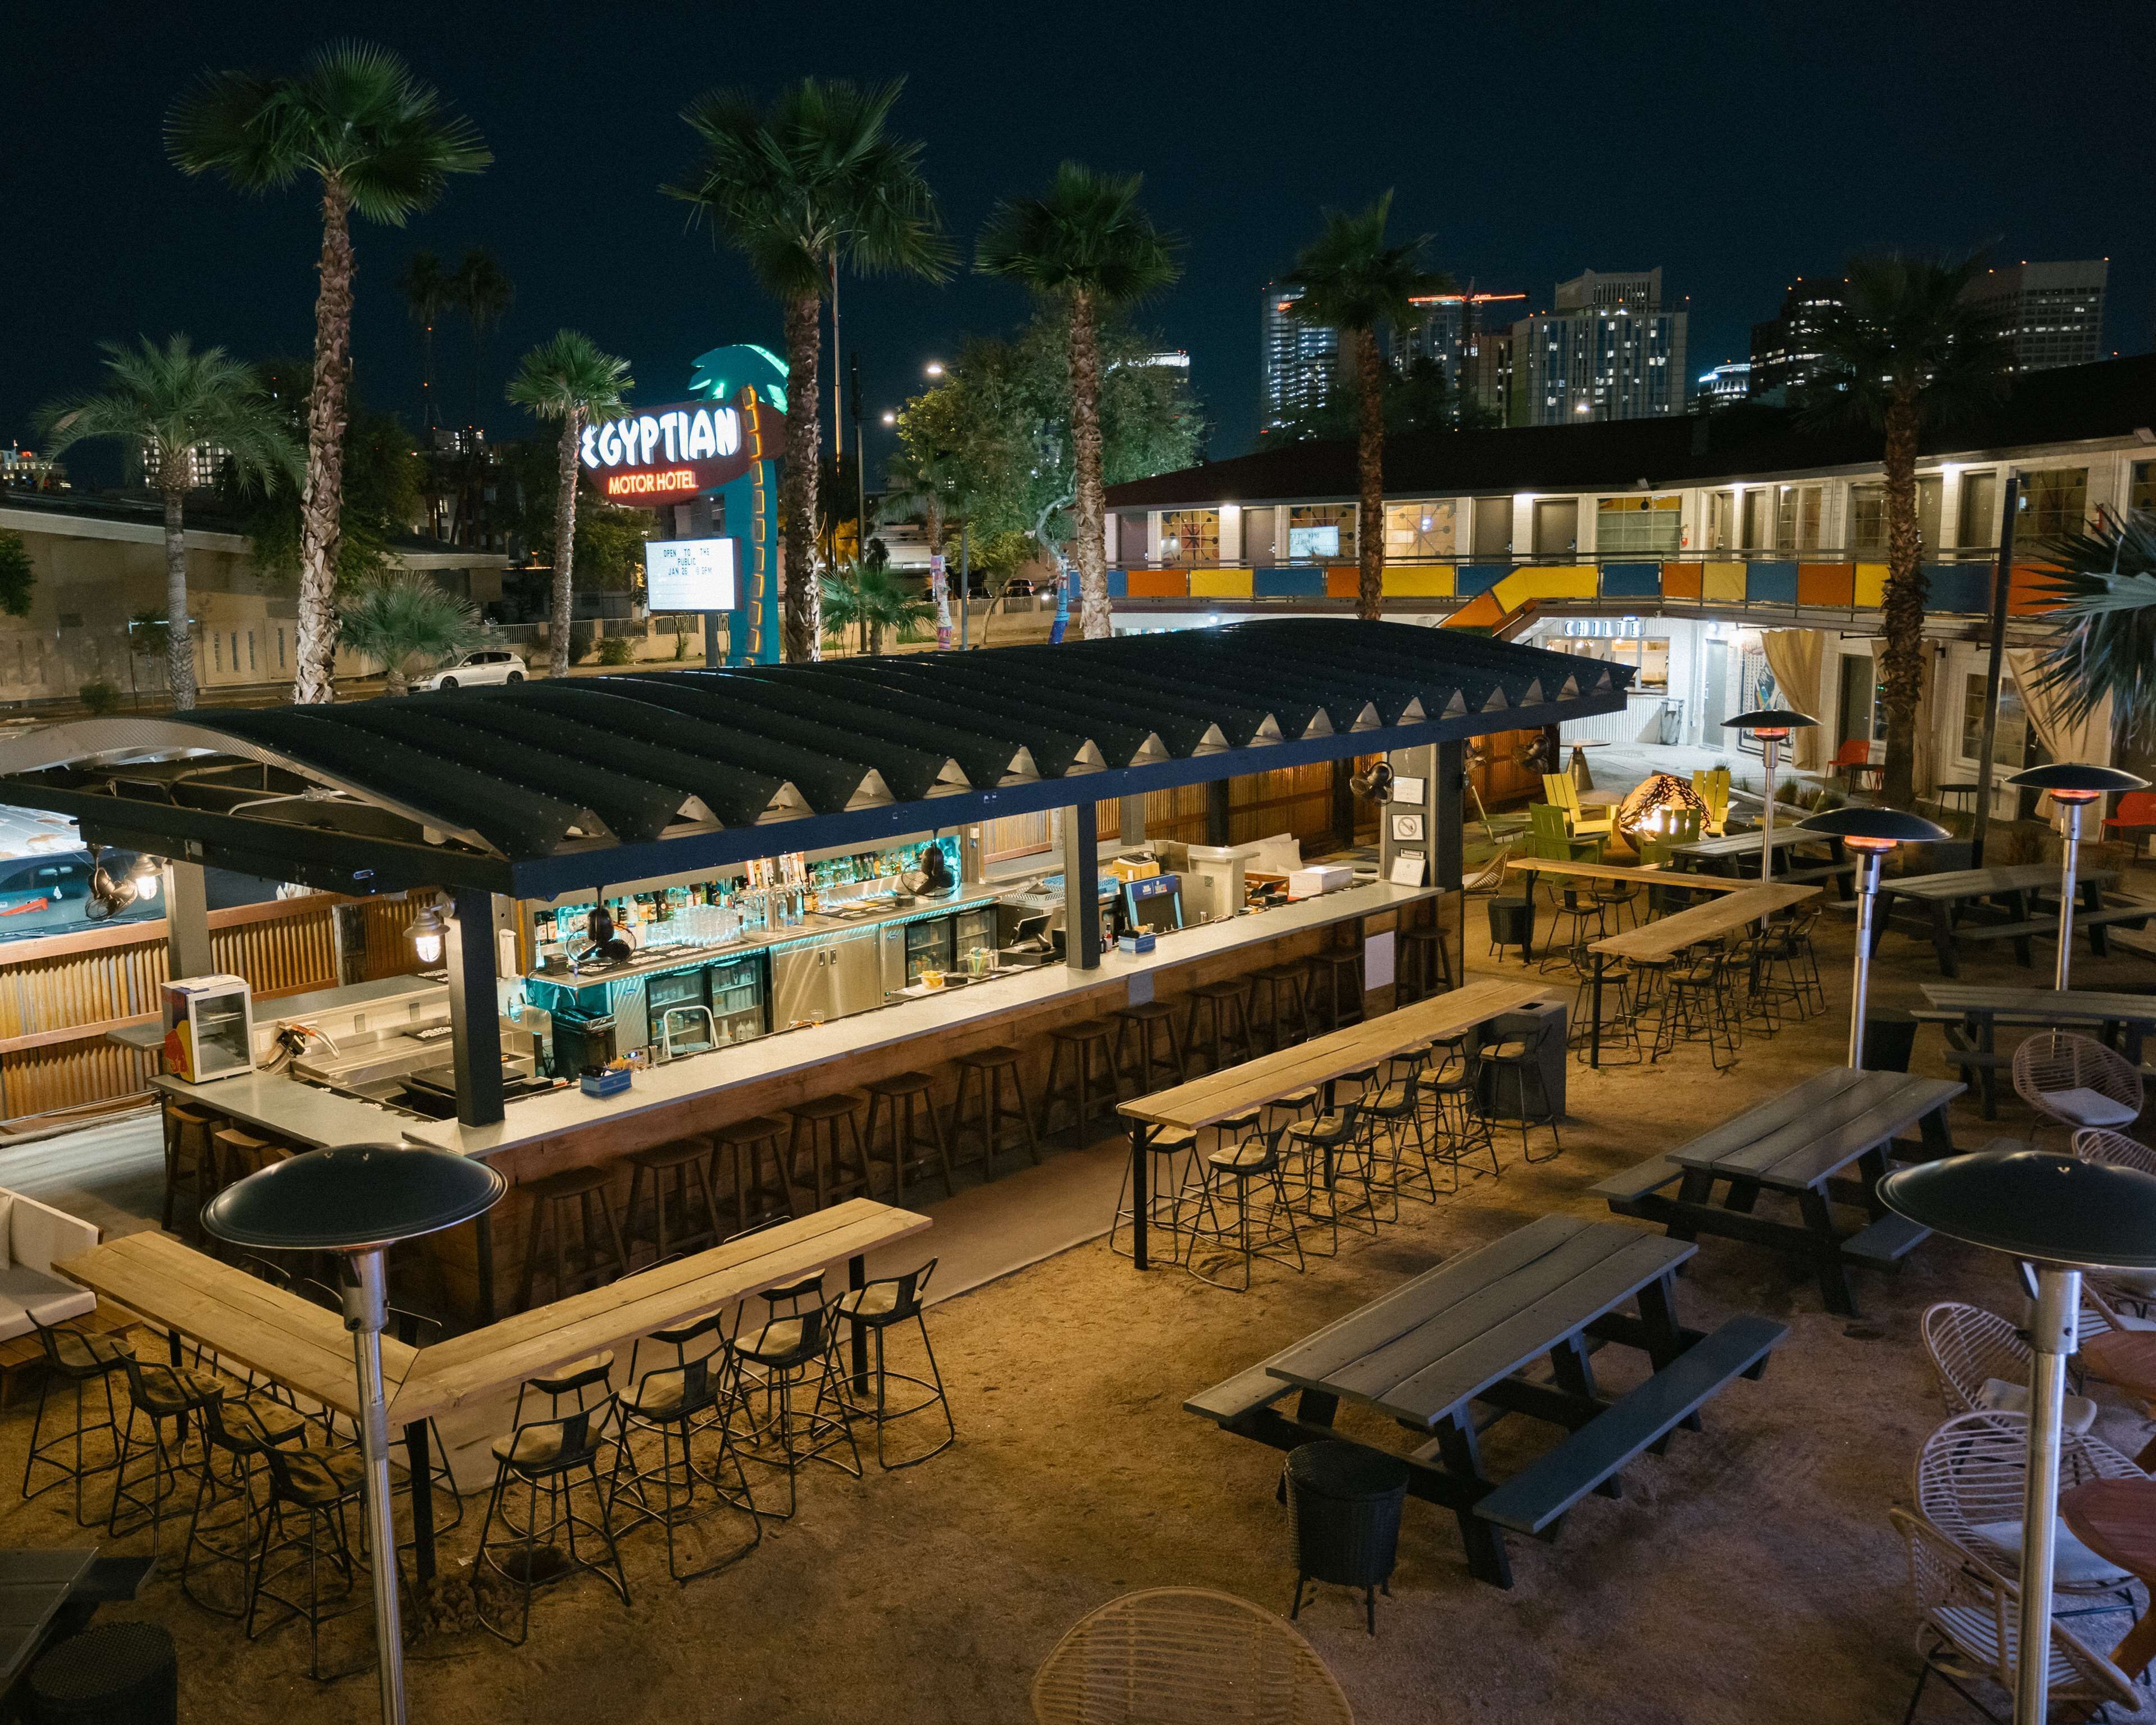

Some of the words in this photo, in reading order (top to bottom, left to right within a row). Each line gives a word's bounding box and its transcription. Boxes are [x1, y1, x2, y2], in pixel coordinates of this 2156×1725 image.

[581, 408, 739, 468] EGYPTIAN
[608, 474, 655, 494] MOTOR
[656, 470, 697, 490] HOTEL
[1565, 621, 1639, 636] CHILTE
